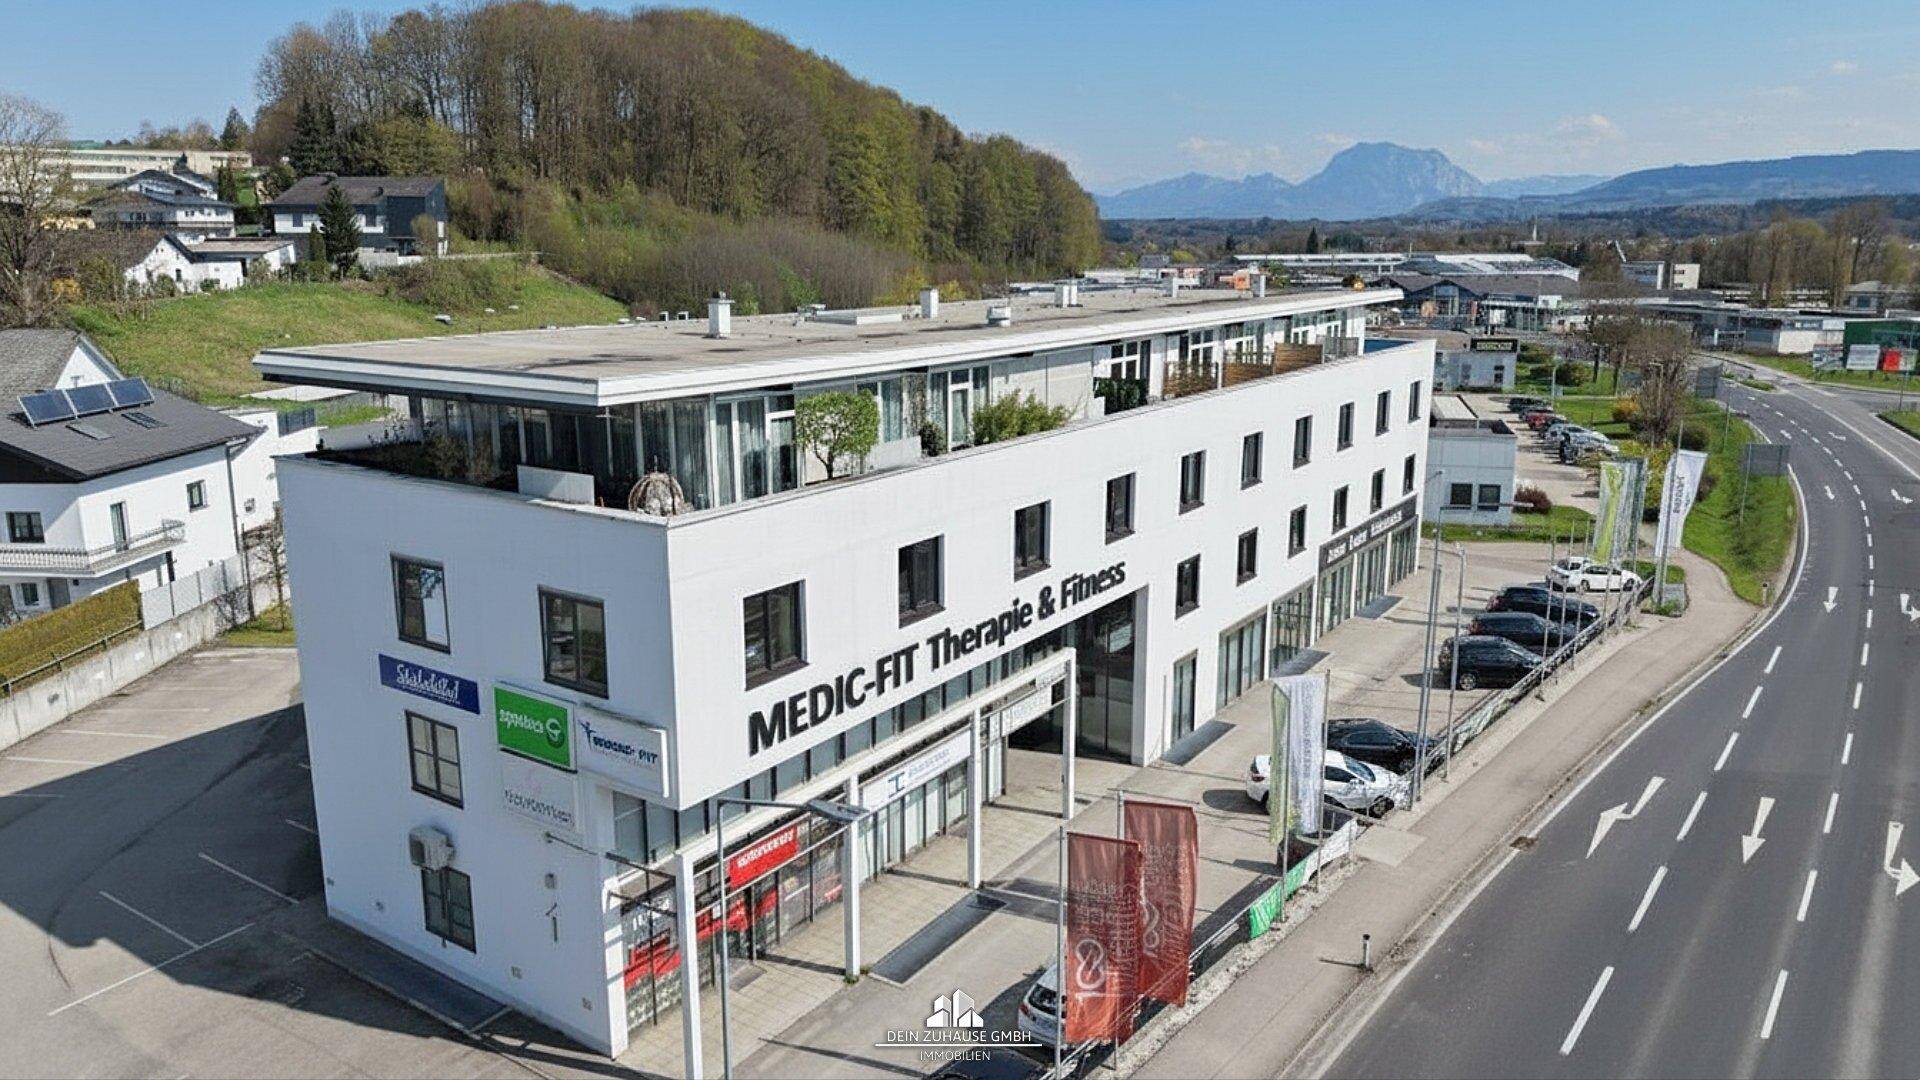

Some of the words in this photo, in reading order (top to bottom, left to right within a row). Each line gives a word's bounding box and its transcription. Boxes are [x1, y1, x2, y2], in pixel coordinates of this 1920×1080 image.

[748, 643, 920, 757] MEDIC-FIT
[926, 597, 1033, 671] Therapie
[1037, 584, 1056, 621] &
[1060, 560, 1127, 611] Fitness
